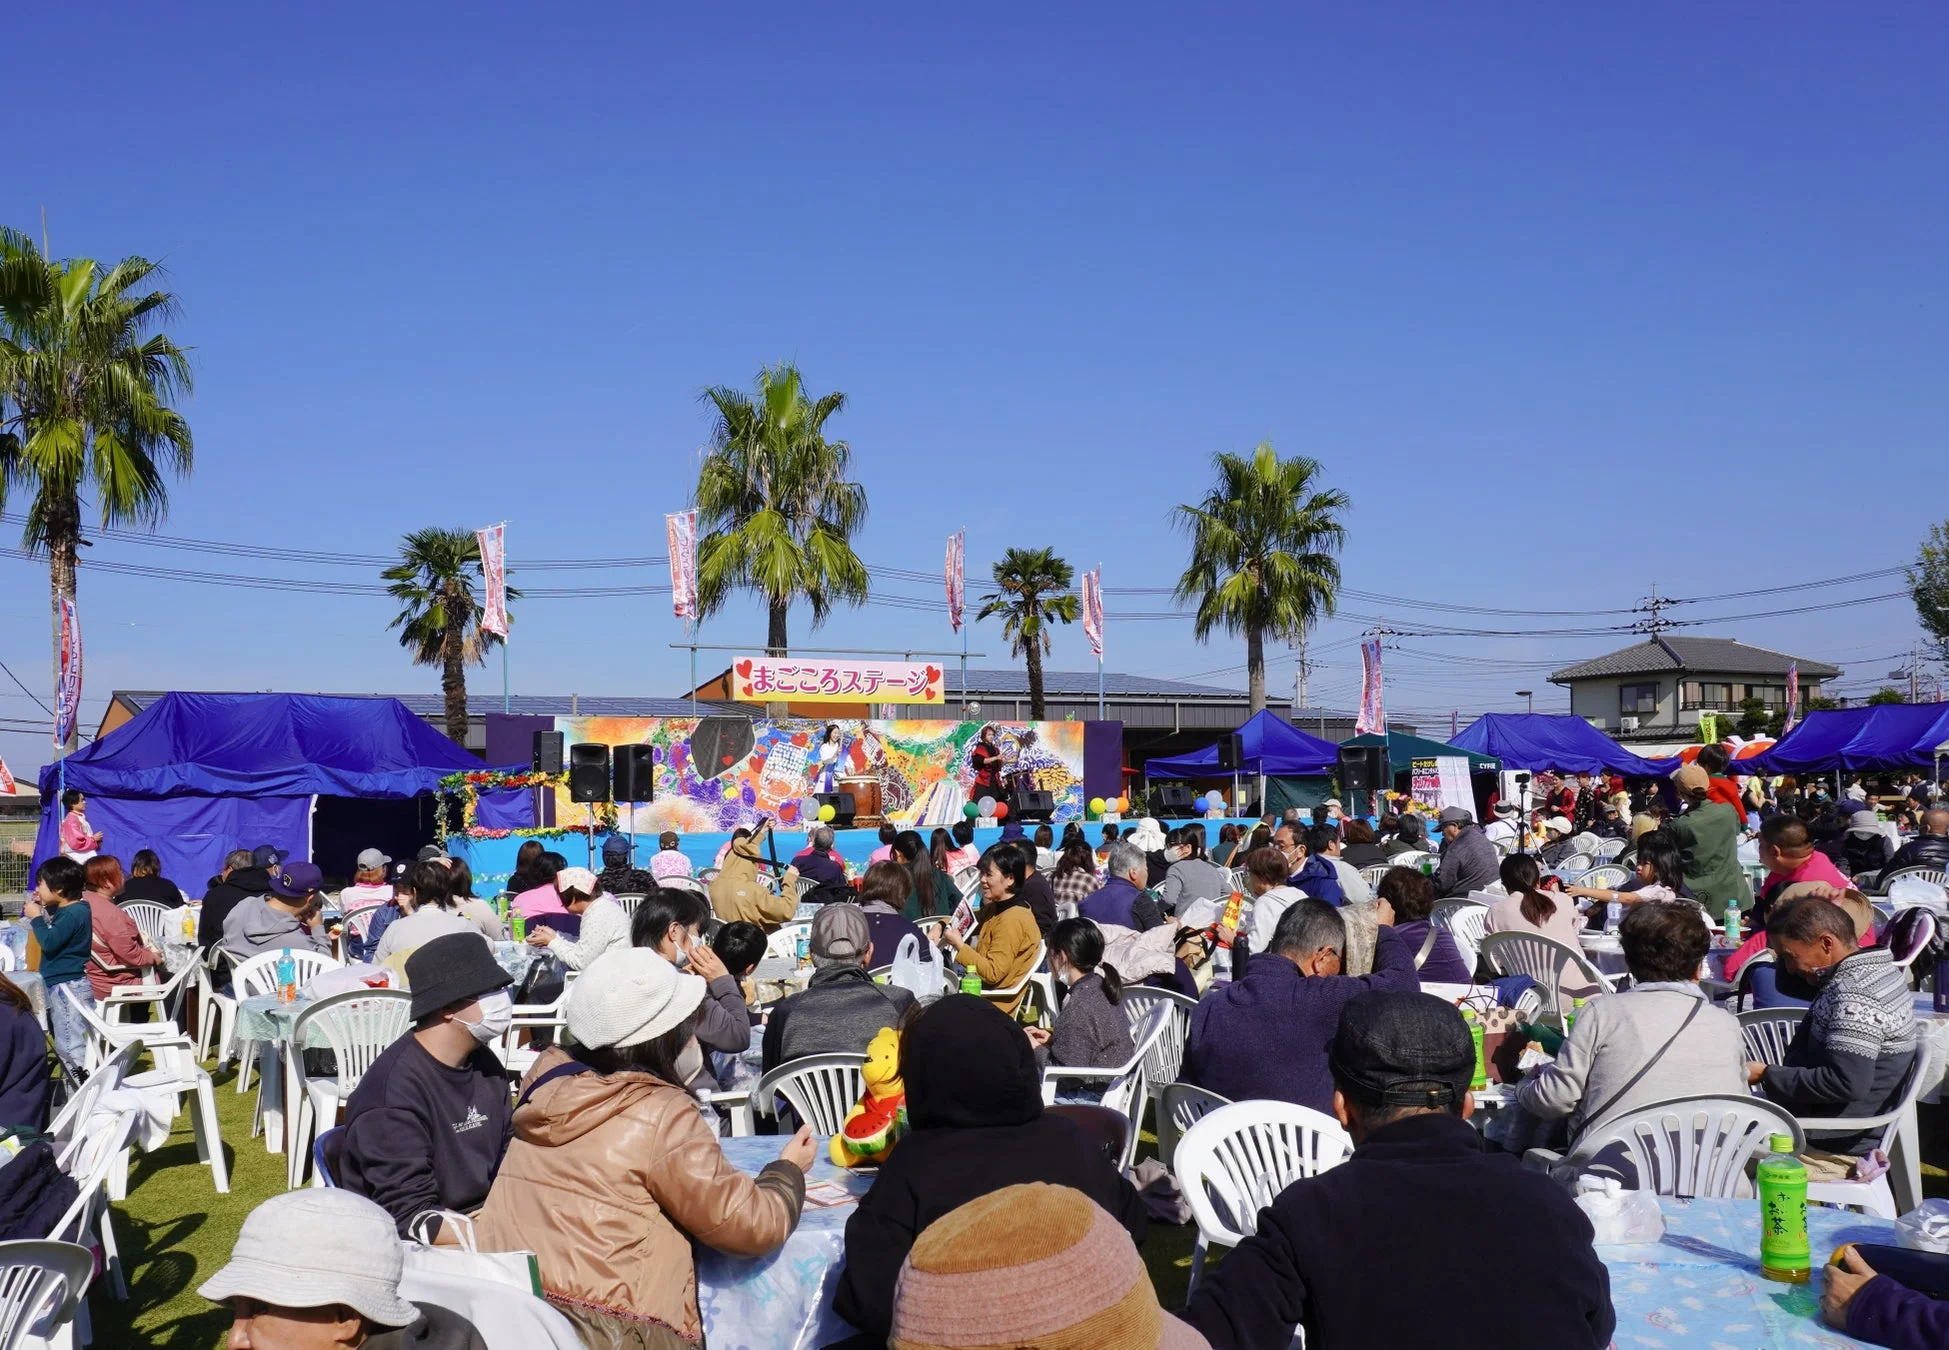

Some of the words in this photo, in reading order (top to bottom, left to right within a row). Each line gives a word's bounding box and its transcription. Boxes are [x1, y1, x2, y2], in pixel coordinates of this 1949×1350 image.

[753, 665, 928, 696] まごころステージ
